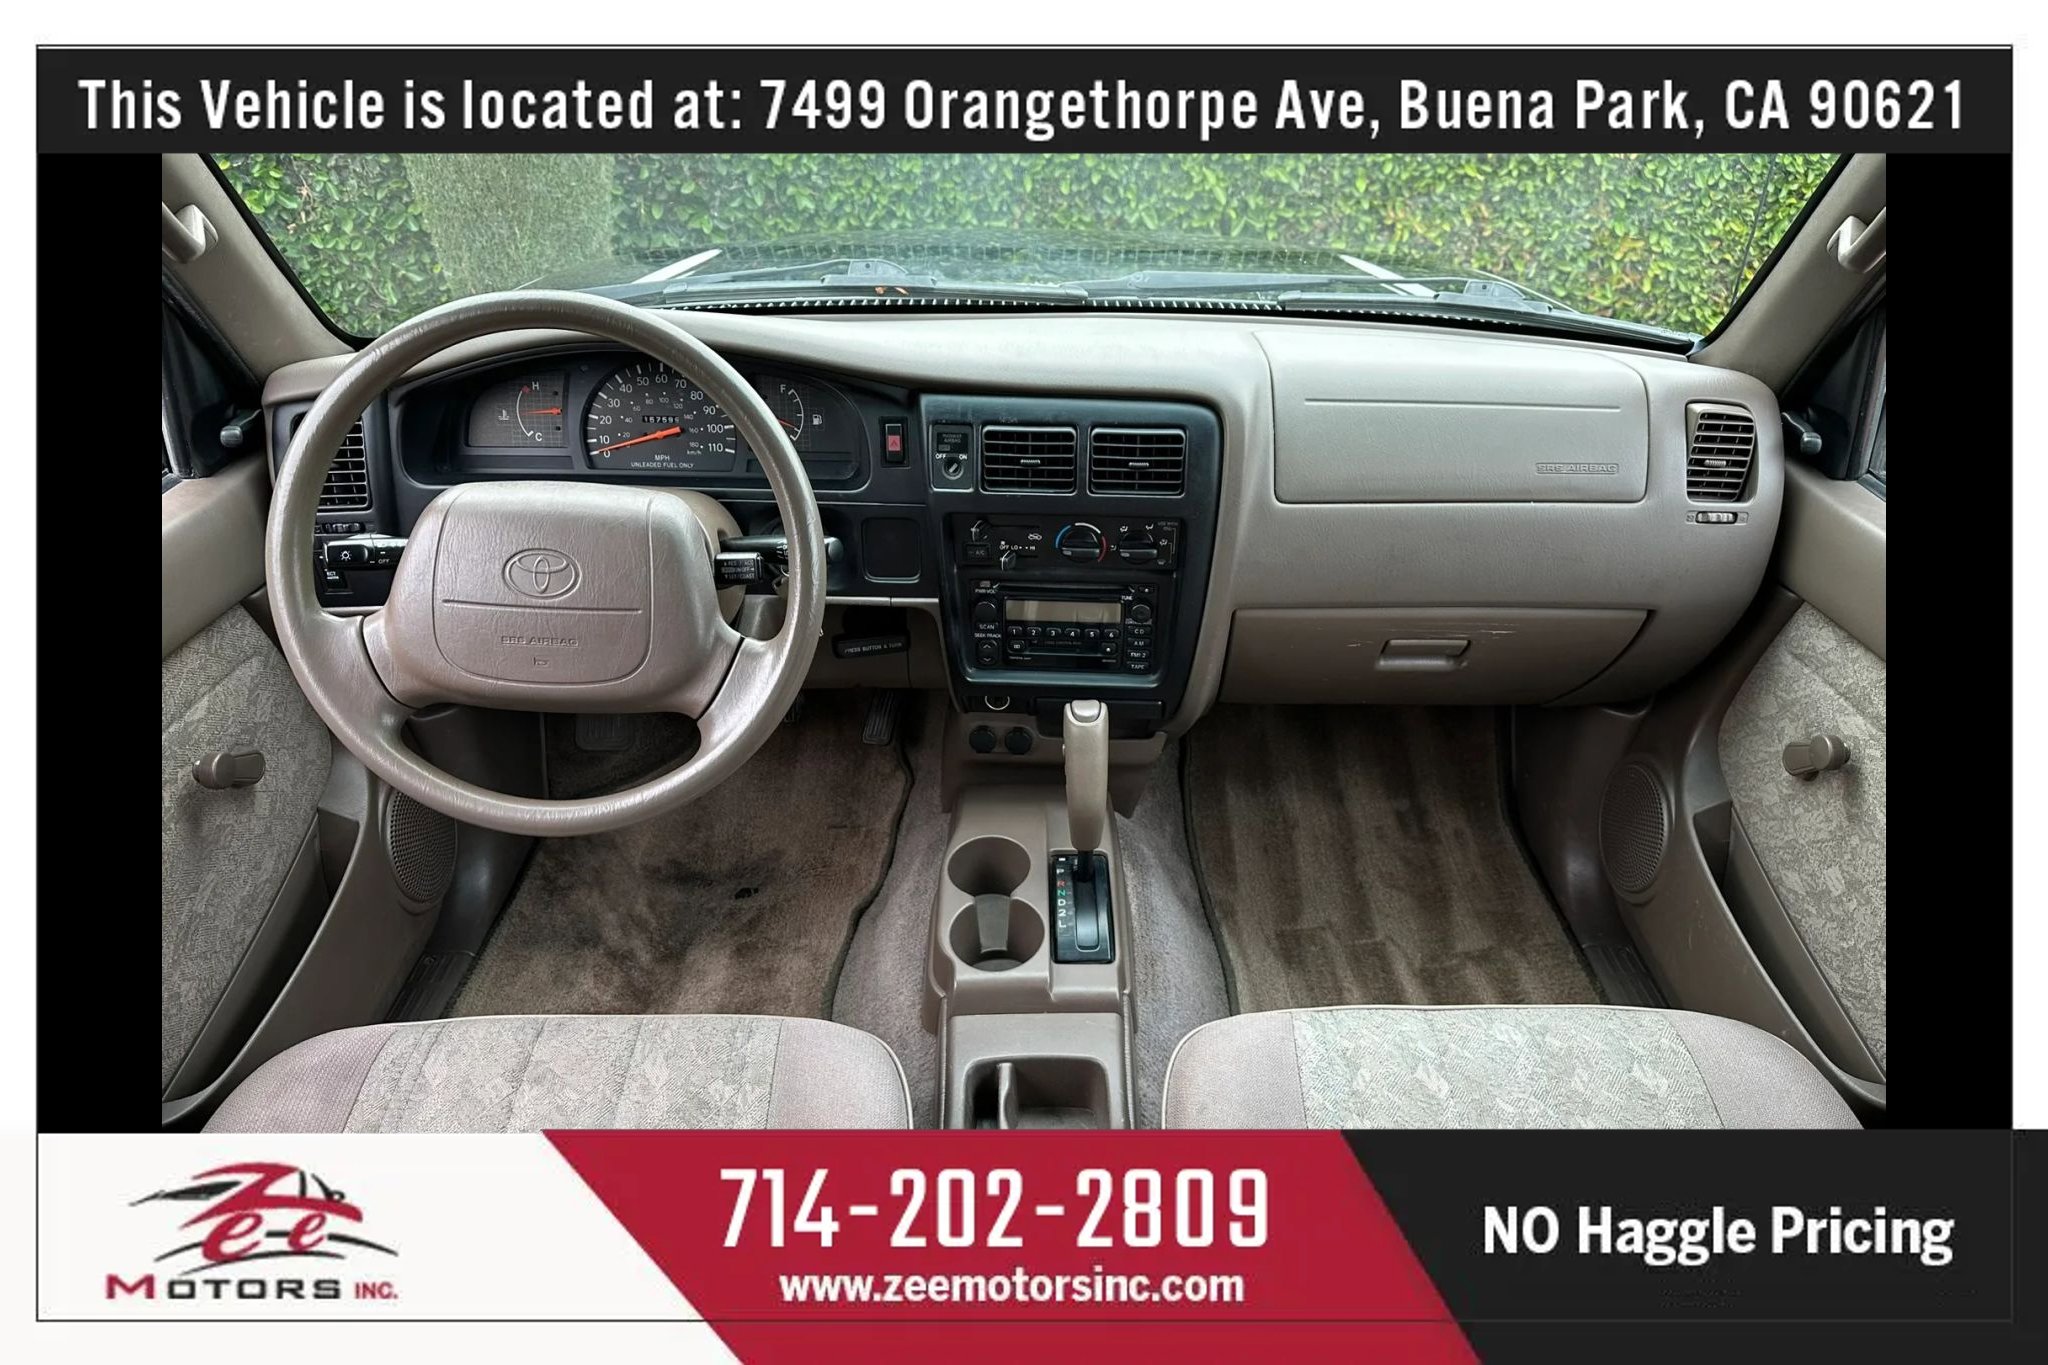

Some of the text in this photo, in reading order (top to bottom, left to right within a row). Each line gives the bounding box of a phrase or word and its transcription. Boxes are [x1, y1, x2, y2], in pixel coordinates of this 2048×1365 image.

[636, 376, 649, 386] 50
[655, 374, 668, 383] 60
[532, 381, 540, 390] H
[674, 379, 687, 388] 70
[619, 384, 632, 393] 40
[780, 385, 786, 393] F
[690, 390, 703, 400] 80
[607, 398, 620, 407] 30
[703, 405, 716, 415] 90
[599, 415, 612, 424] 20
[707, 424, 723, 433] 100
[535, 432, 542, 441] C
[599, 435, 610, 444] 10
[708, 443, 723, 452] 110
[1537, 464, 1617, 472] SRS AIRBAG
[501, 636, 579, 648] SRS AIRBAG
[1057, 889, 1066, 897] N
[1057, 898, 1066, 906] D
[1058, 909, 1067, 917] 2
[1058, 920, 1067, 928] L
